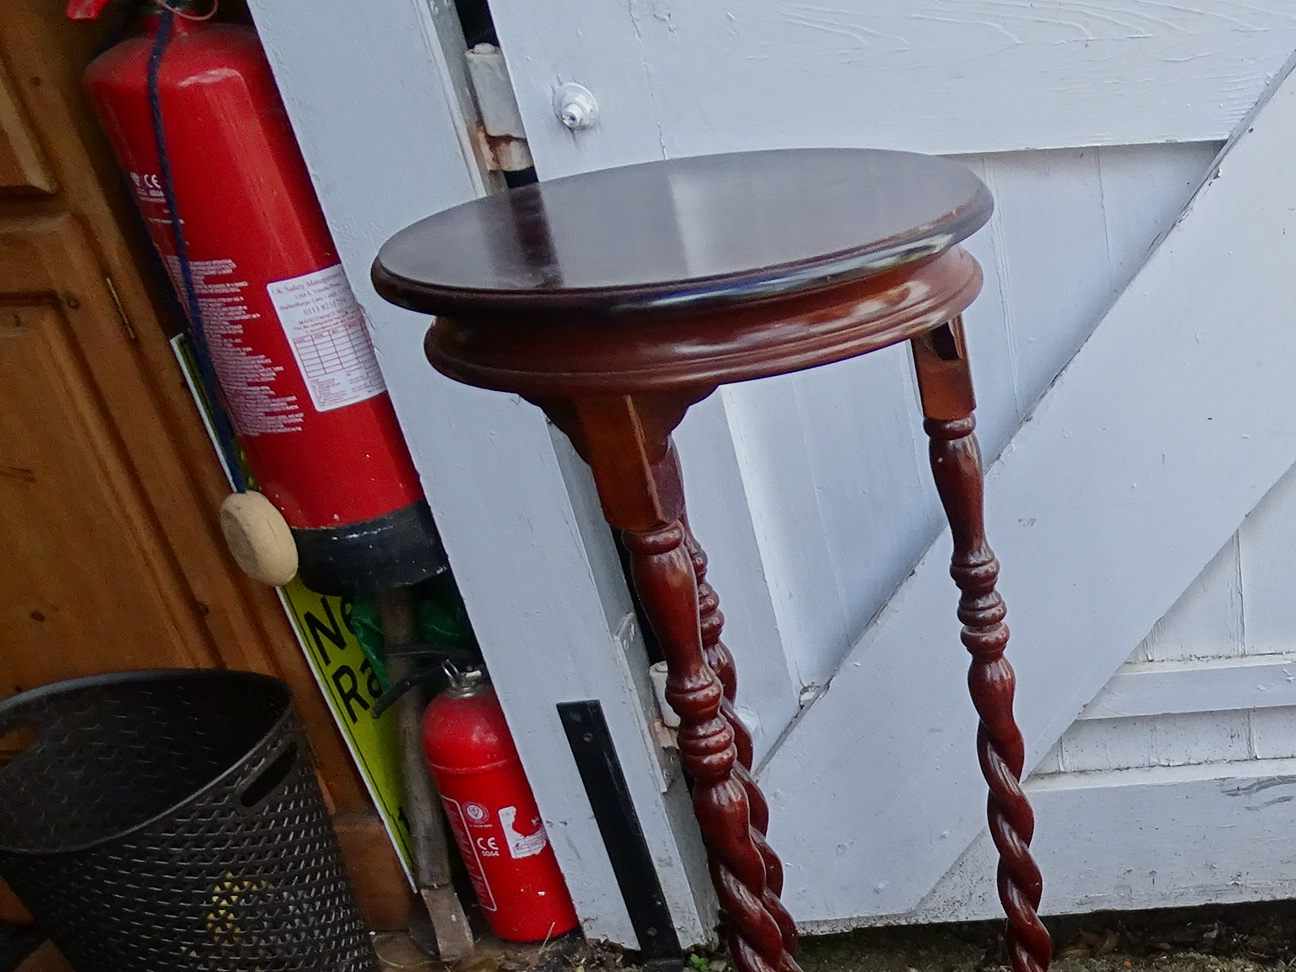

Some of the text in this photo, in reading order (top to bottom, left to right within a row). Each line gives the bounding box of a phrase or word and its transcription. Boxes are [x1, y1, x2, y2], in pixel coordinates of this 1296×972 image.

[143, 173, 162, 189] CE
[331, 658, 384, 724] Ra
[476, 836, 500, 850] CE
